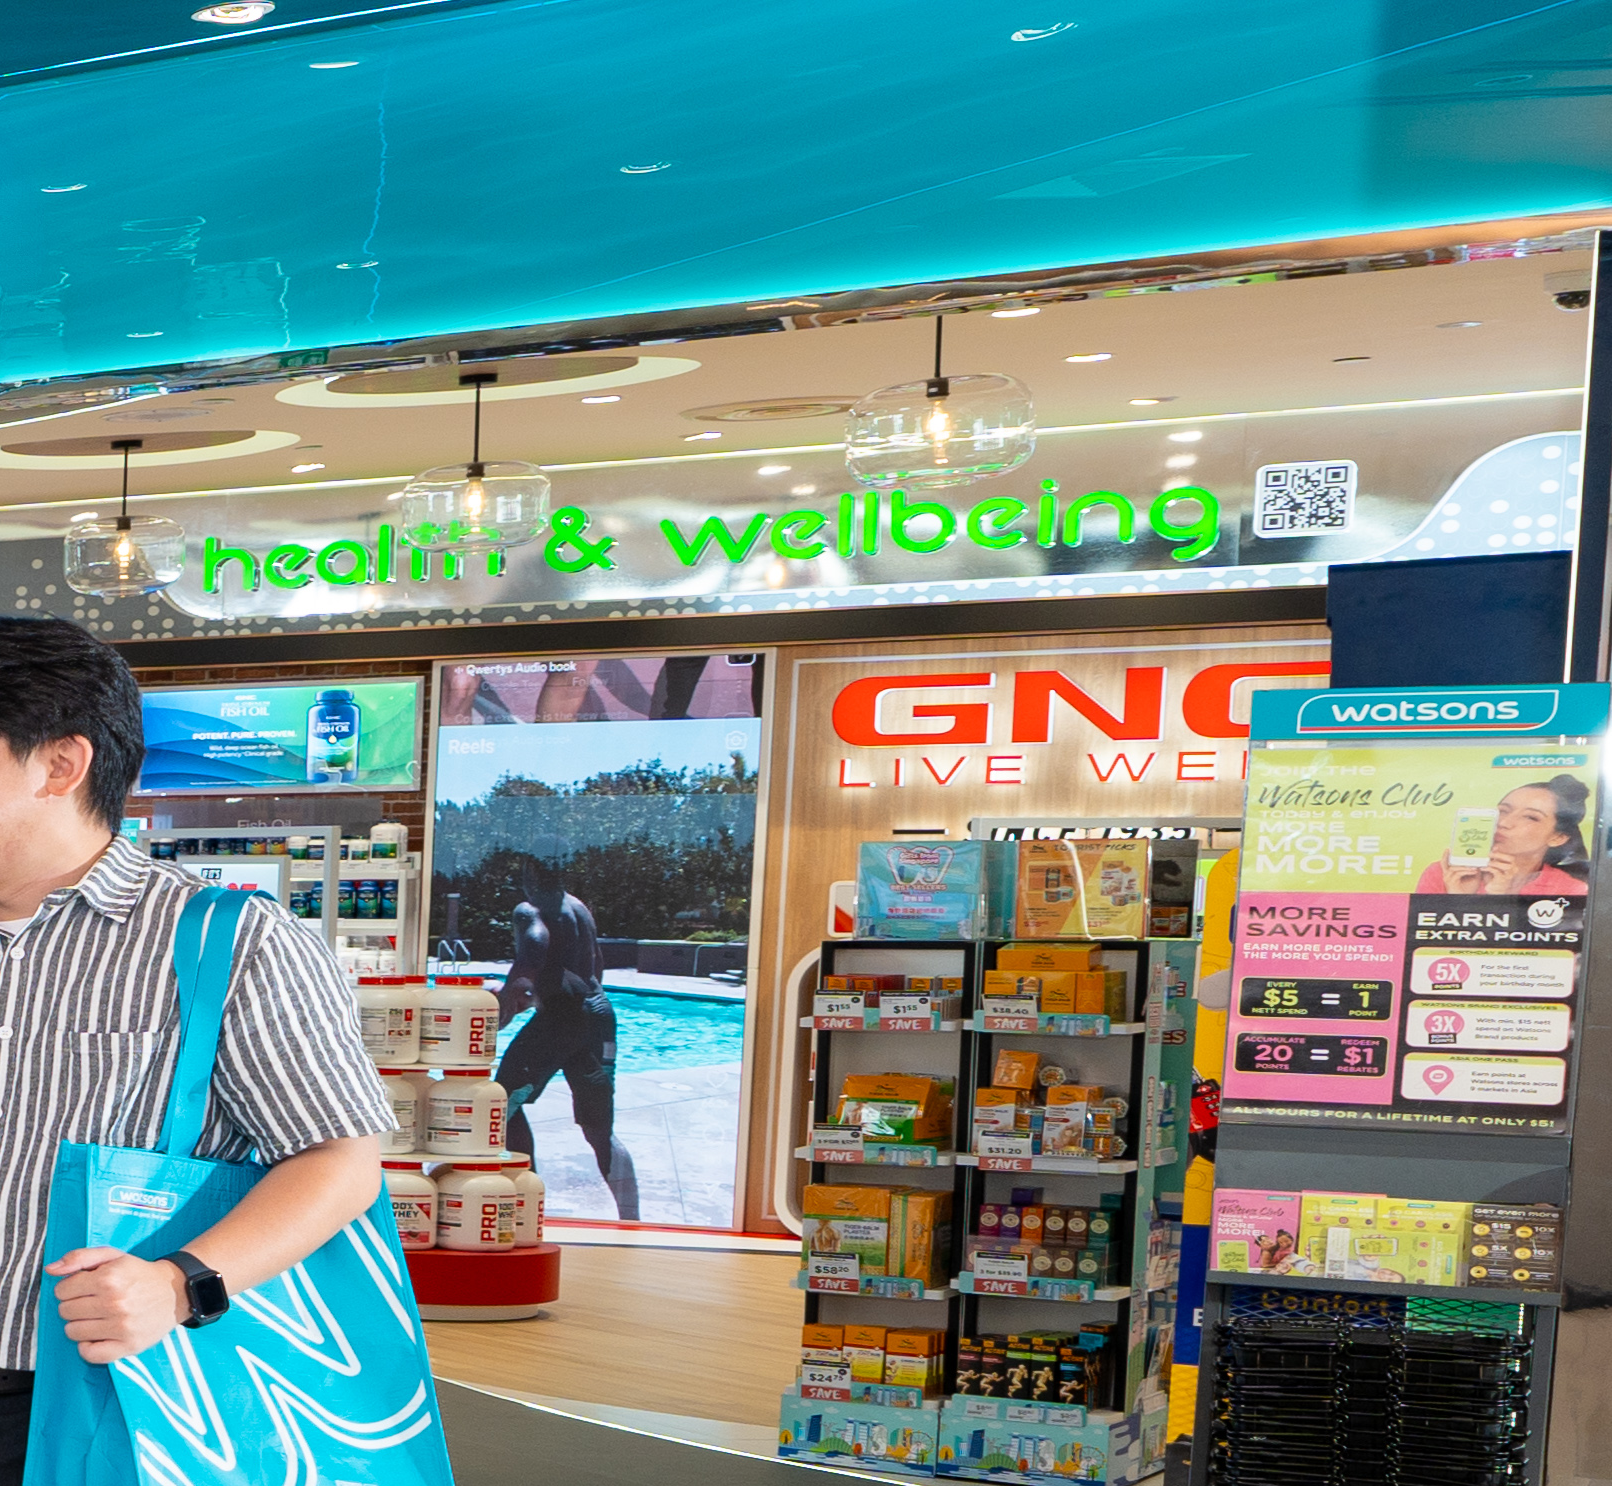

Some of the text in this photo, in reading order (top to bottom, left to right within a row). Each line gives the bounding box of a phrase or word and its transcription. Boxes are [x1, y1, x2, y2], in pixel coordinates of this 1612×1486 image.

[544, 505, 618, 573] &
[659, 477, 1221, 568] wellbeing
[466, 660, 577, 678] Qwertys Audio book
[220, 705, 270, 717] FISH OIL
[1332, 700, 1519, 723] watsons
[448, 737, 495, 756] Reels
[1503, 756, 1575, 766] watsons
[838, 755, 1026, 788] LIVE
[1258, 780, 1454, 808] Watsons Club
[1259, 822, 1344, 833] MORE
[1258, 835, 1380, 853] MORE
[1255, 855, 1413, 875] MORE!
[1248, 906, 1351, 920] MORE
[1417, 912, 1510, 927] EARN
[1246, 923, 1397, 938] SAVINGS
[1415, 930, 1579, 942] EXTRA POINTS
[1243, 943, 1373, 952] EARN MORE POINTS
[1272, 952, 1309, 960] MORE
[1314, 952, 1341, 961] YOU
[1345, 953, 1393, 961] SPEND!
[1435, 963, 1462, 981] 5X
[1263, 988, 1299, 1007] $5
[1359, 991, 1369, 1008] 1
[822, 1019, 854, 1029] SAVE
[1431, 1016, 1456, 1032] 3X
[469, 1017, 485, 1056] PRO
[1254, 1044, 1294, 1061] 20
[1344, 1047, 1373, 1066] $1
[489, 1108, 502, 1147] PRO
[119, 1189, 168, 1207] watsons
[481, 1204, 497, 1242] PRO
[817, 1279, 850, 1290] SAVE
[983, 1281, 1017, 1293] SAVE
[809, 1388, 841, 1399] SAVE
